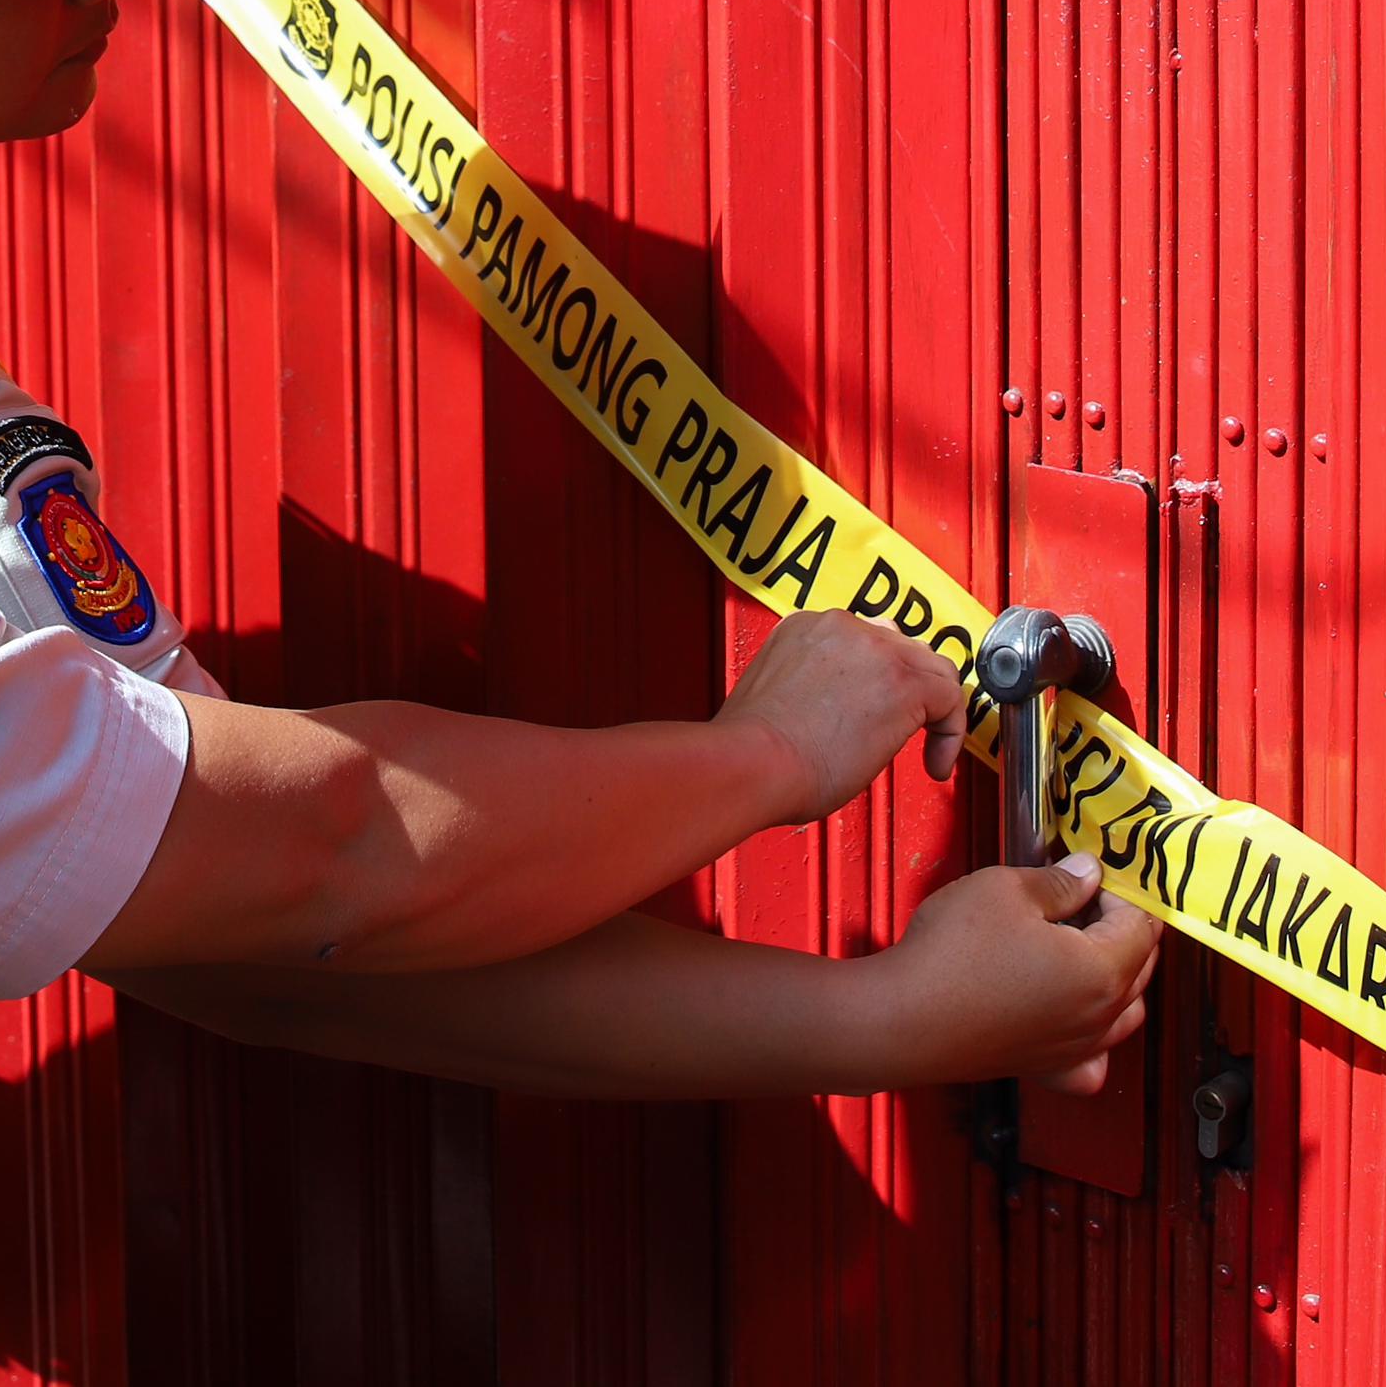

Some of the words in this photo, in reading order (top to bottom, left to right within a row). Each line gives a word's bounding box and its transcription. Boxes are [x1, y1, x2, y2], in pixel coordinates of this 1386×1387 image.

[342, 43, 468, 231] POLISI
[460, 184, 668, 446] PAMONG
[655, 399, 838, 610] PRAJA
[1099, 785, 1213, 912] DKI
